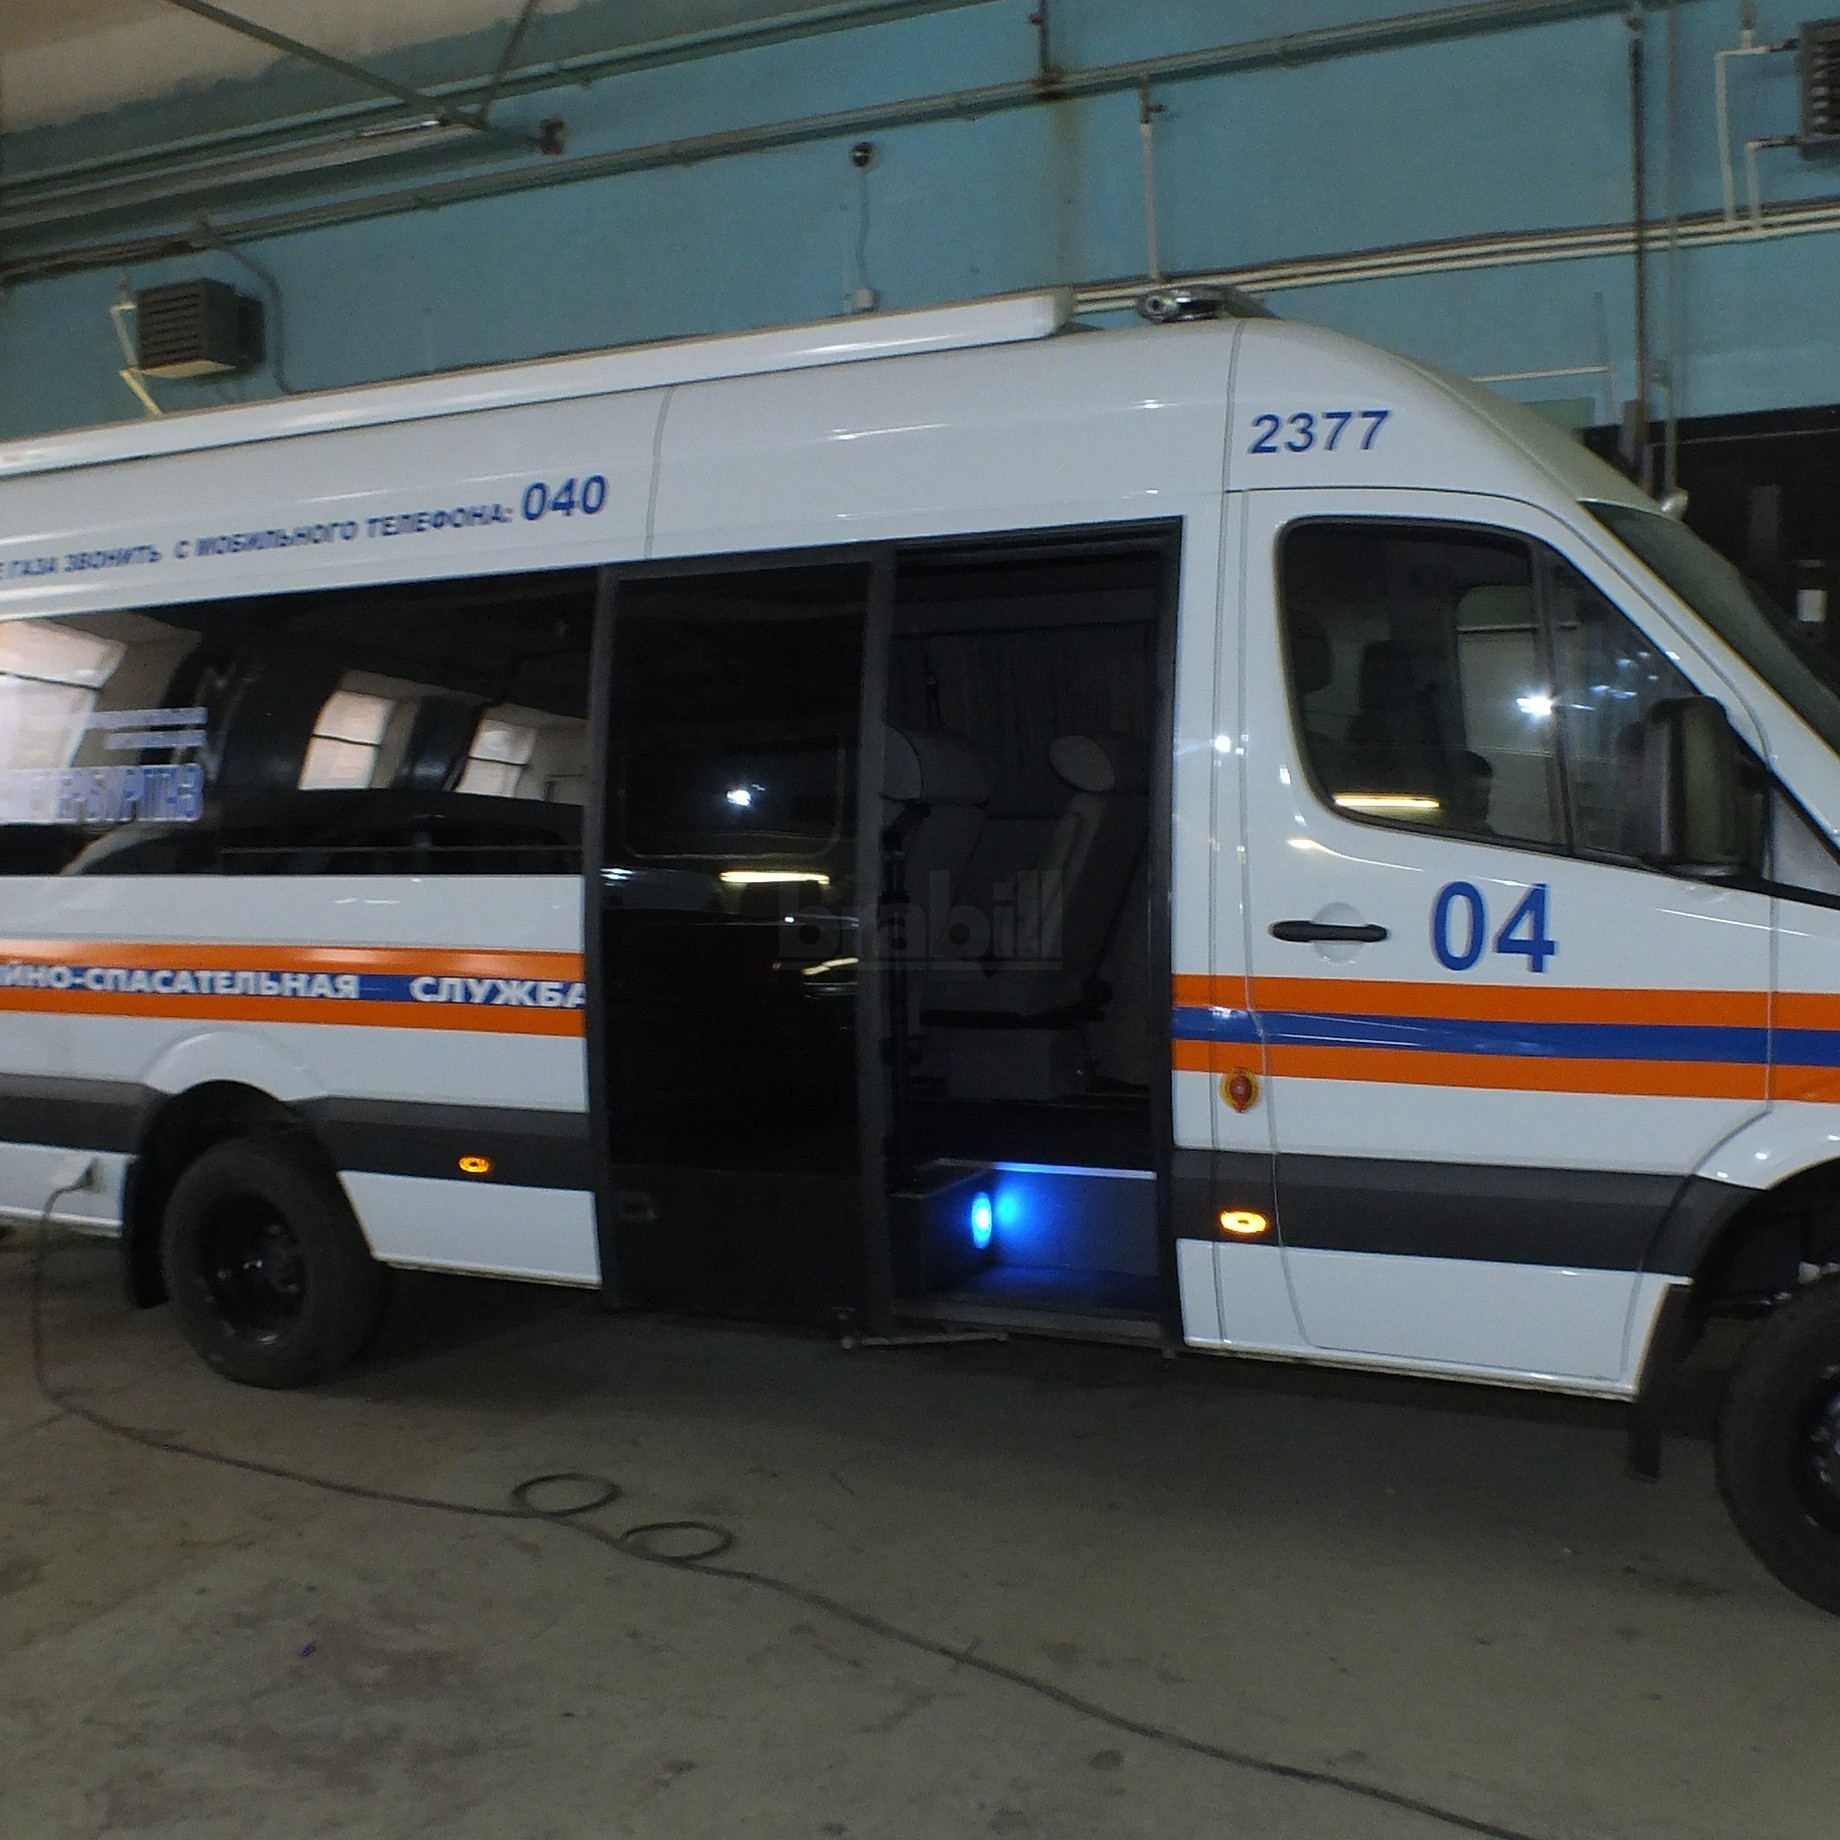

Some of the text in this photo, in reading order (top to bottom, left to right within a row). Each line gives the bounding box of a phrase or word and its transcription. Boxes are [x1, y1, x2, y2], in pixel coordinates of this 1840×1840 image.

[1248, 409, 1391, 454] 2377
[8, 556, 59, 579] ГАЗА
[64, 544, 162, 573] ЗВОНИТЬ
[195, 520, 360, 557] МОБИЛЬНОГО
[366, 502, 513, 538] ТЕЛЕФОНА:
[521, 474, 608, 522] 040
[1430, 881, 1557, 973] 04
[409, 975, 586, 1009] СЛУЖБА
